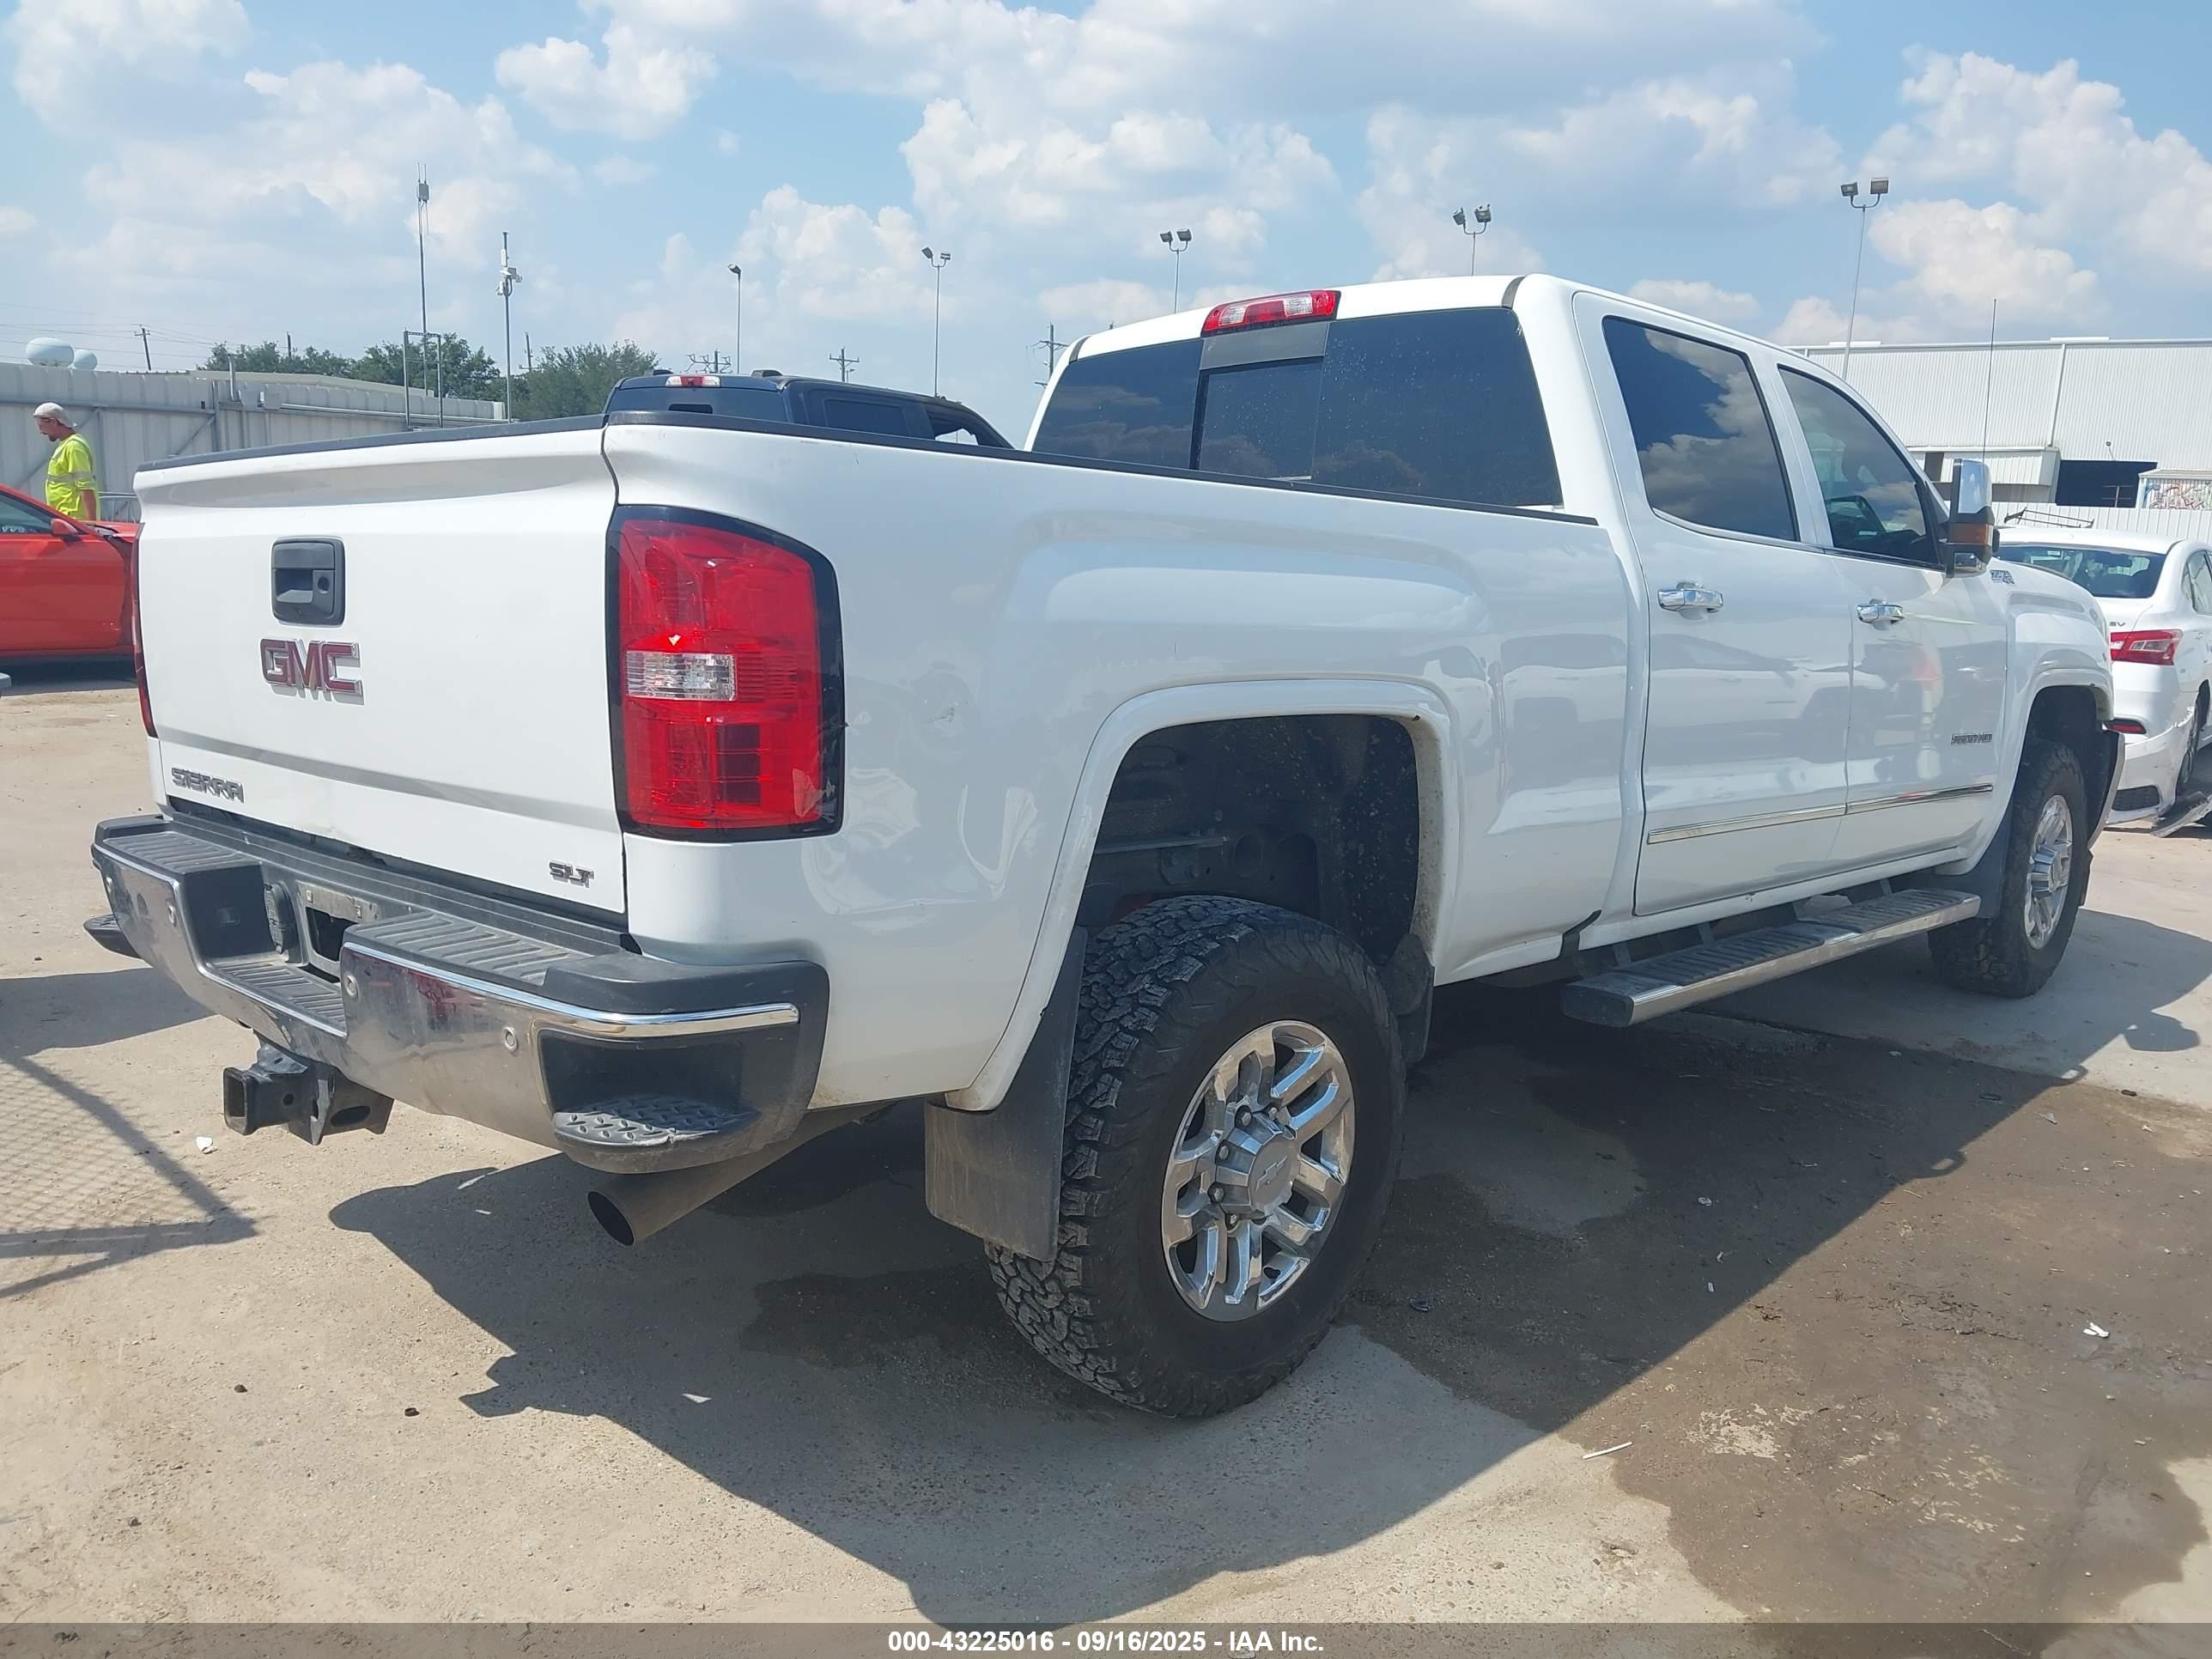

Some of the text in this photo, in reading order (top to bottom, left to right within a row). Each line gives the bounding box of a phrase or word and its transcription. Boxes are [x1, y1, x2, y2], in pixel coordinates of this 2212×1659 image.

[260, 638, 362, 697] GMC
[171, 767, 245, 804] SIERRA
[549, 860, 594, 888] SLT
